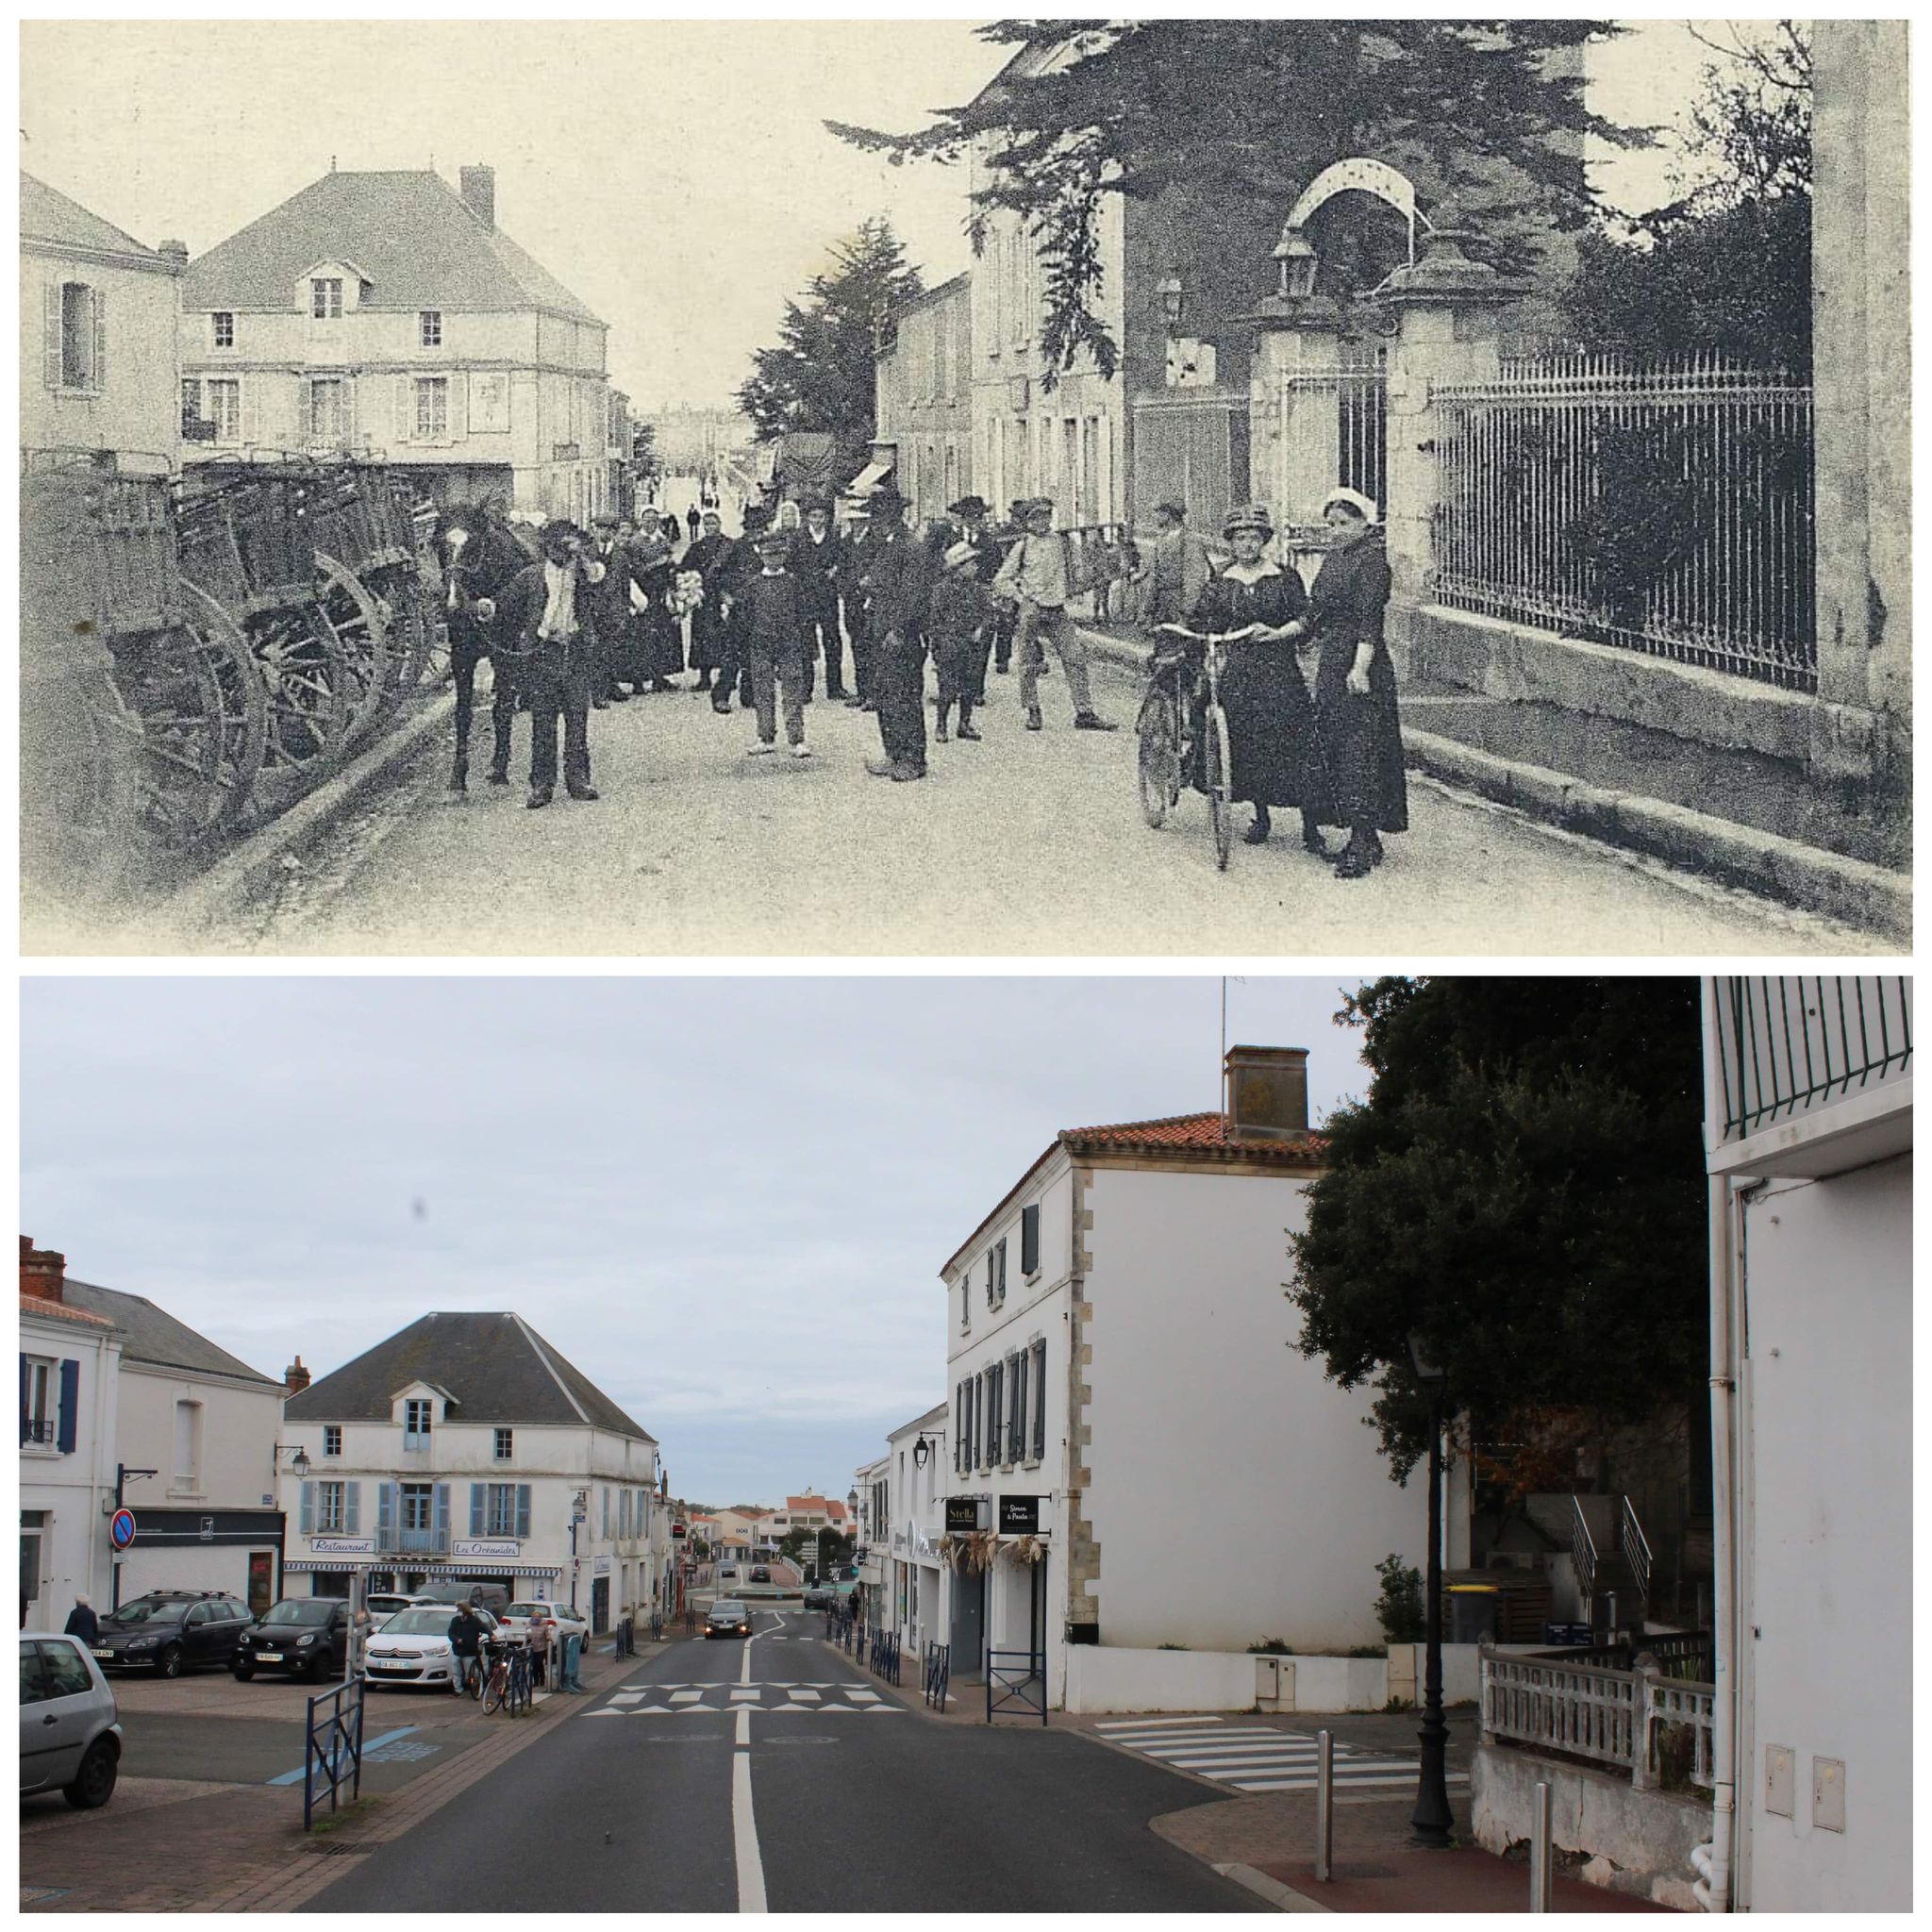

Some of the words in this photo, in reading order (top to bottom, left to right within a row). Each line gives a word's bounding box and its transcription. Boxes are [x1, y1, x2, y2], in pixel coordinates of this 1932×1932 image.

[949, 1508, 974, 1519] Stella
[1009, 1504, 1027, 1513] Simon
[1011, 1512, 1028, 1521] Paula
[315, 1540, 372, 1551] Restaurant
[456, 1543, 470, 1554] Les
[472, 1543, 517, 1555] Océanides
